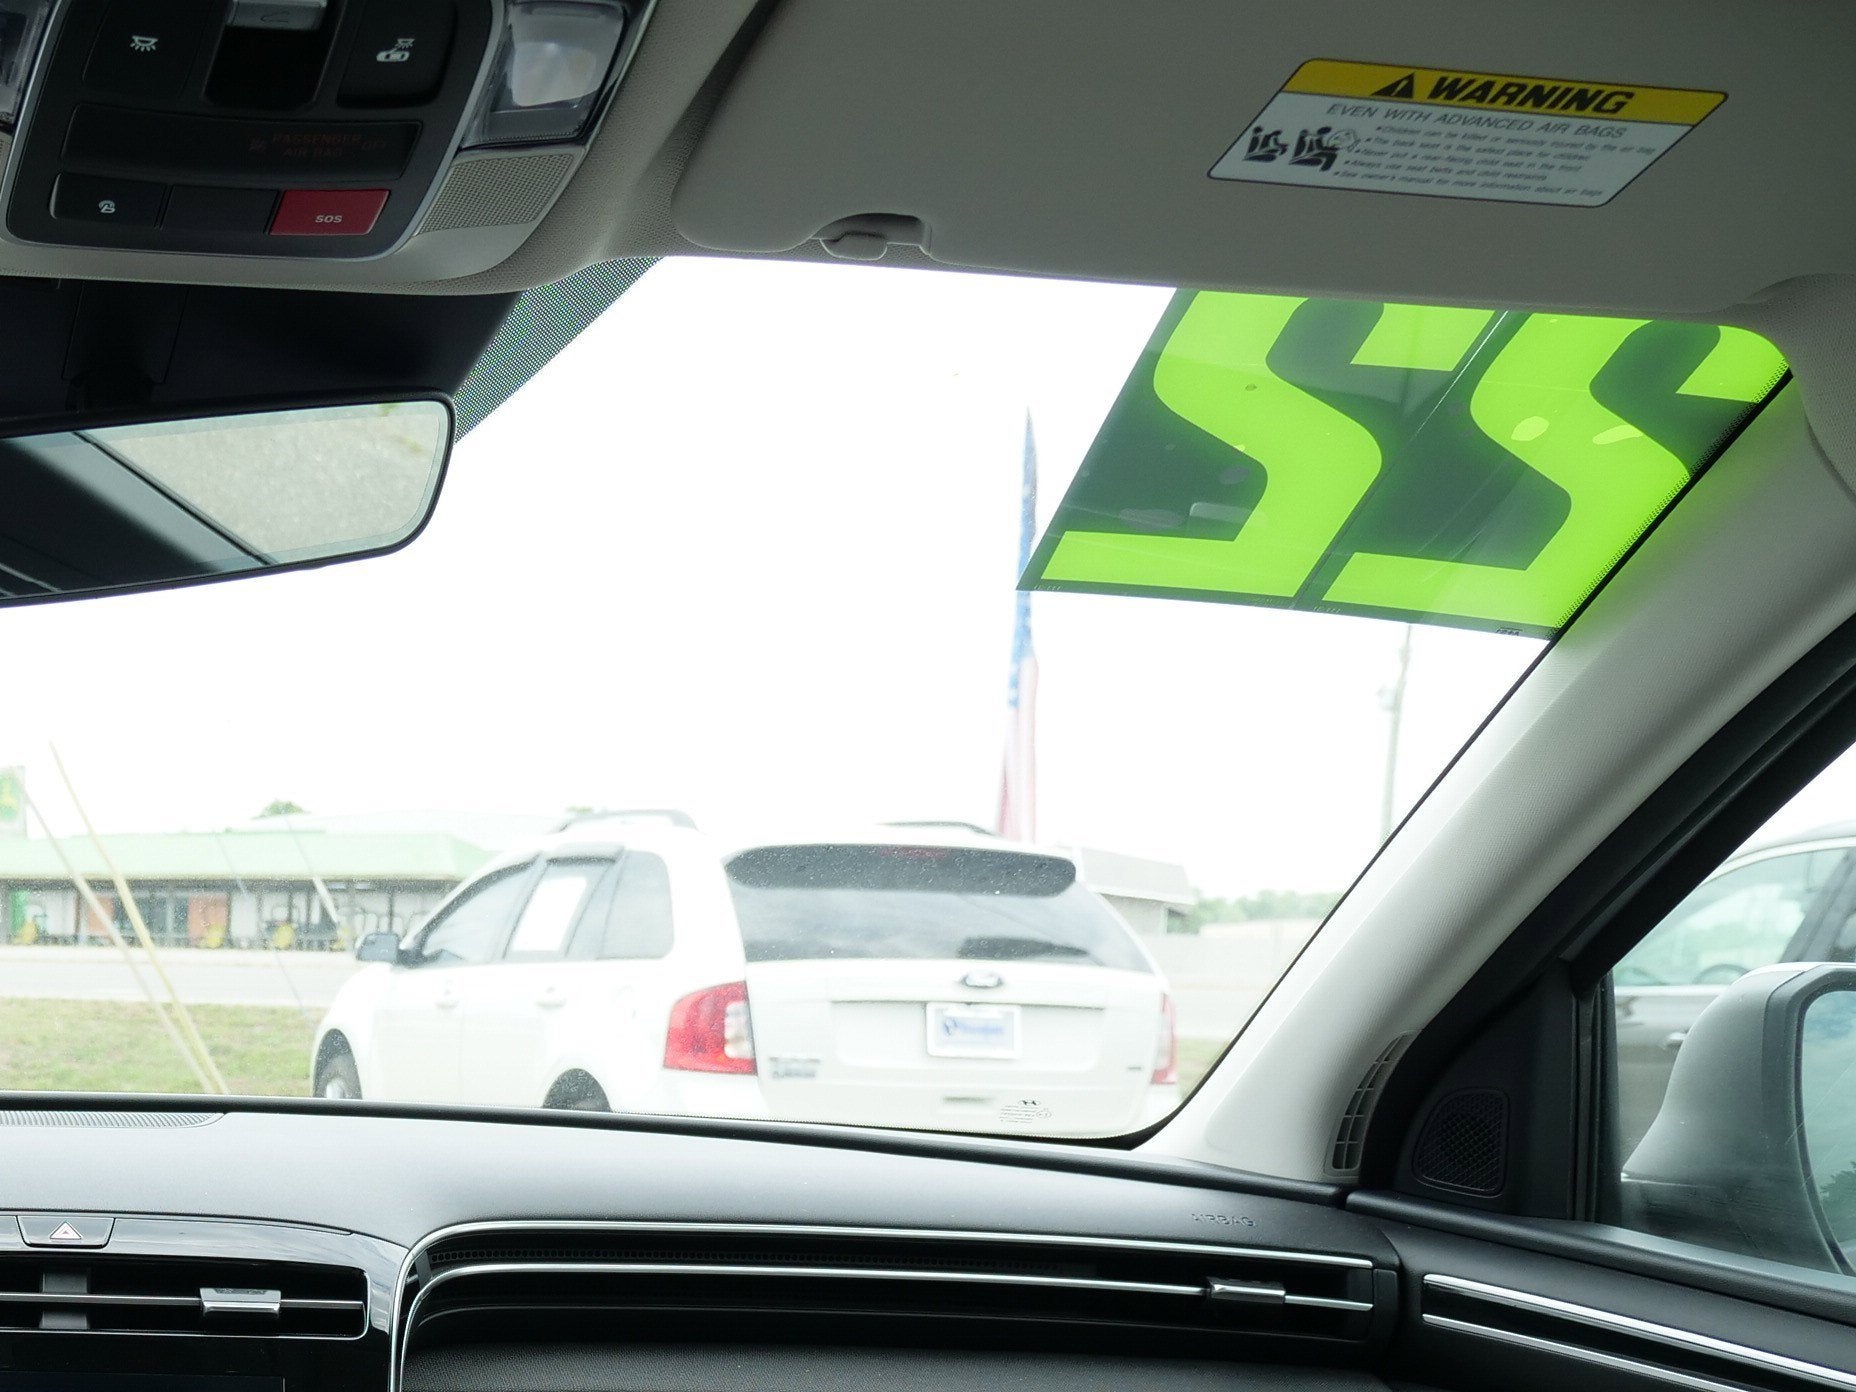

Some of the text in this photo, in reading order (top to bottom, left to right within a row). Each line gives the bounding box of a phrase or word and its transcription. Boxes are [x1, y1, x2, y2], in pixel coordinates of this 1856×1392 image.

[1427, 76, 1634, 115] WARNING
[1326, 103, 1628, 139] EVEN WITH ADVANCED AIR BAGS
[315, 214, 343, 224] SOS
